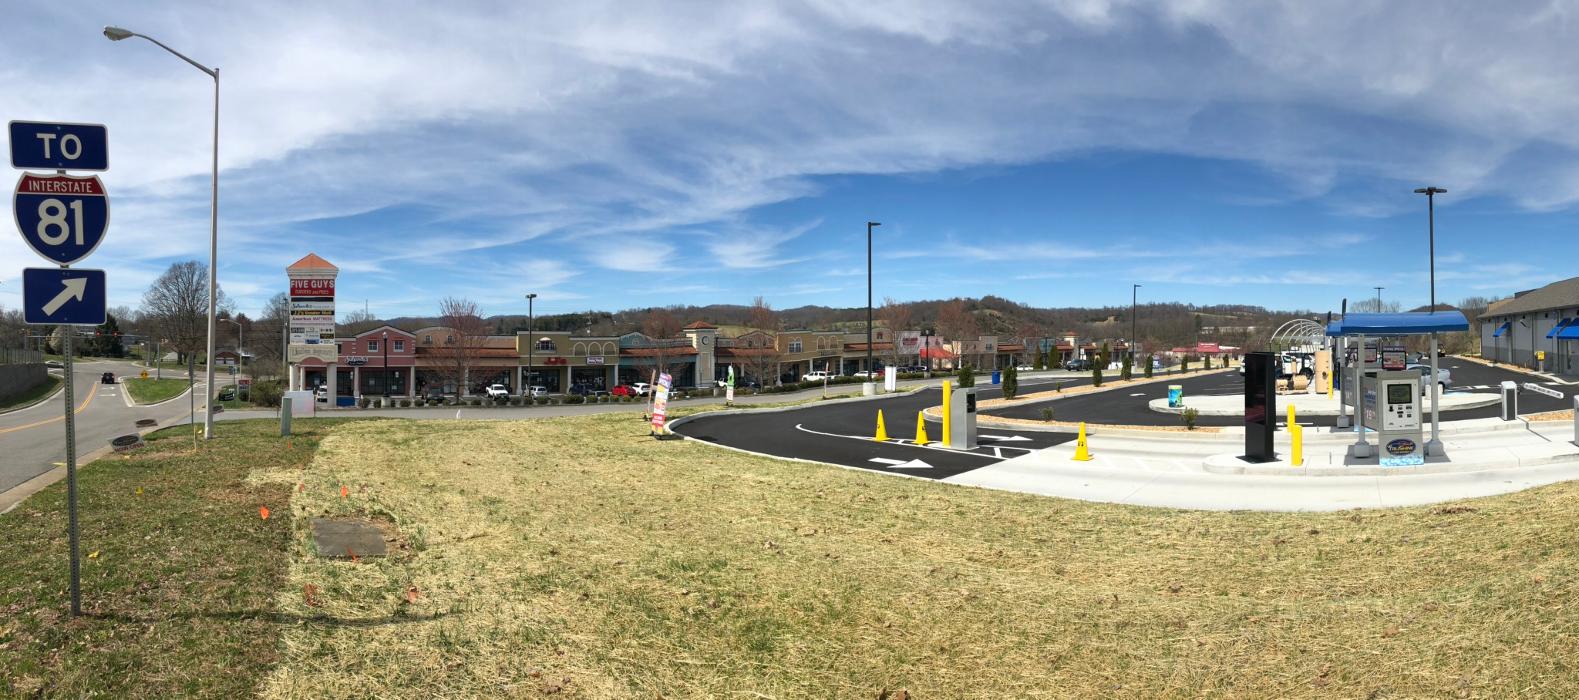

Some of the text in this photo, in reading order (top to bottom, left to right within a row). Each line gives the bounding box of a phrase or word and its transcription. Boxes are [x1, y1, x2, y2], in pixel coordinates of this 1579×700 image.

[36, 133, 82, 160] TO
[28, 180, 93, 193] INTERSTATE
[37, 198, 84, 246] 81
[290, 279, 335, 289] FIVE GUYS
